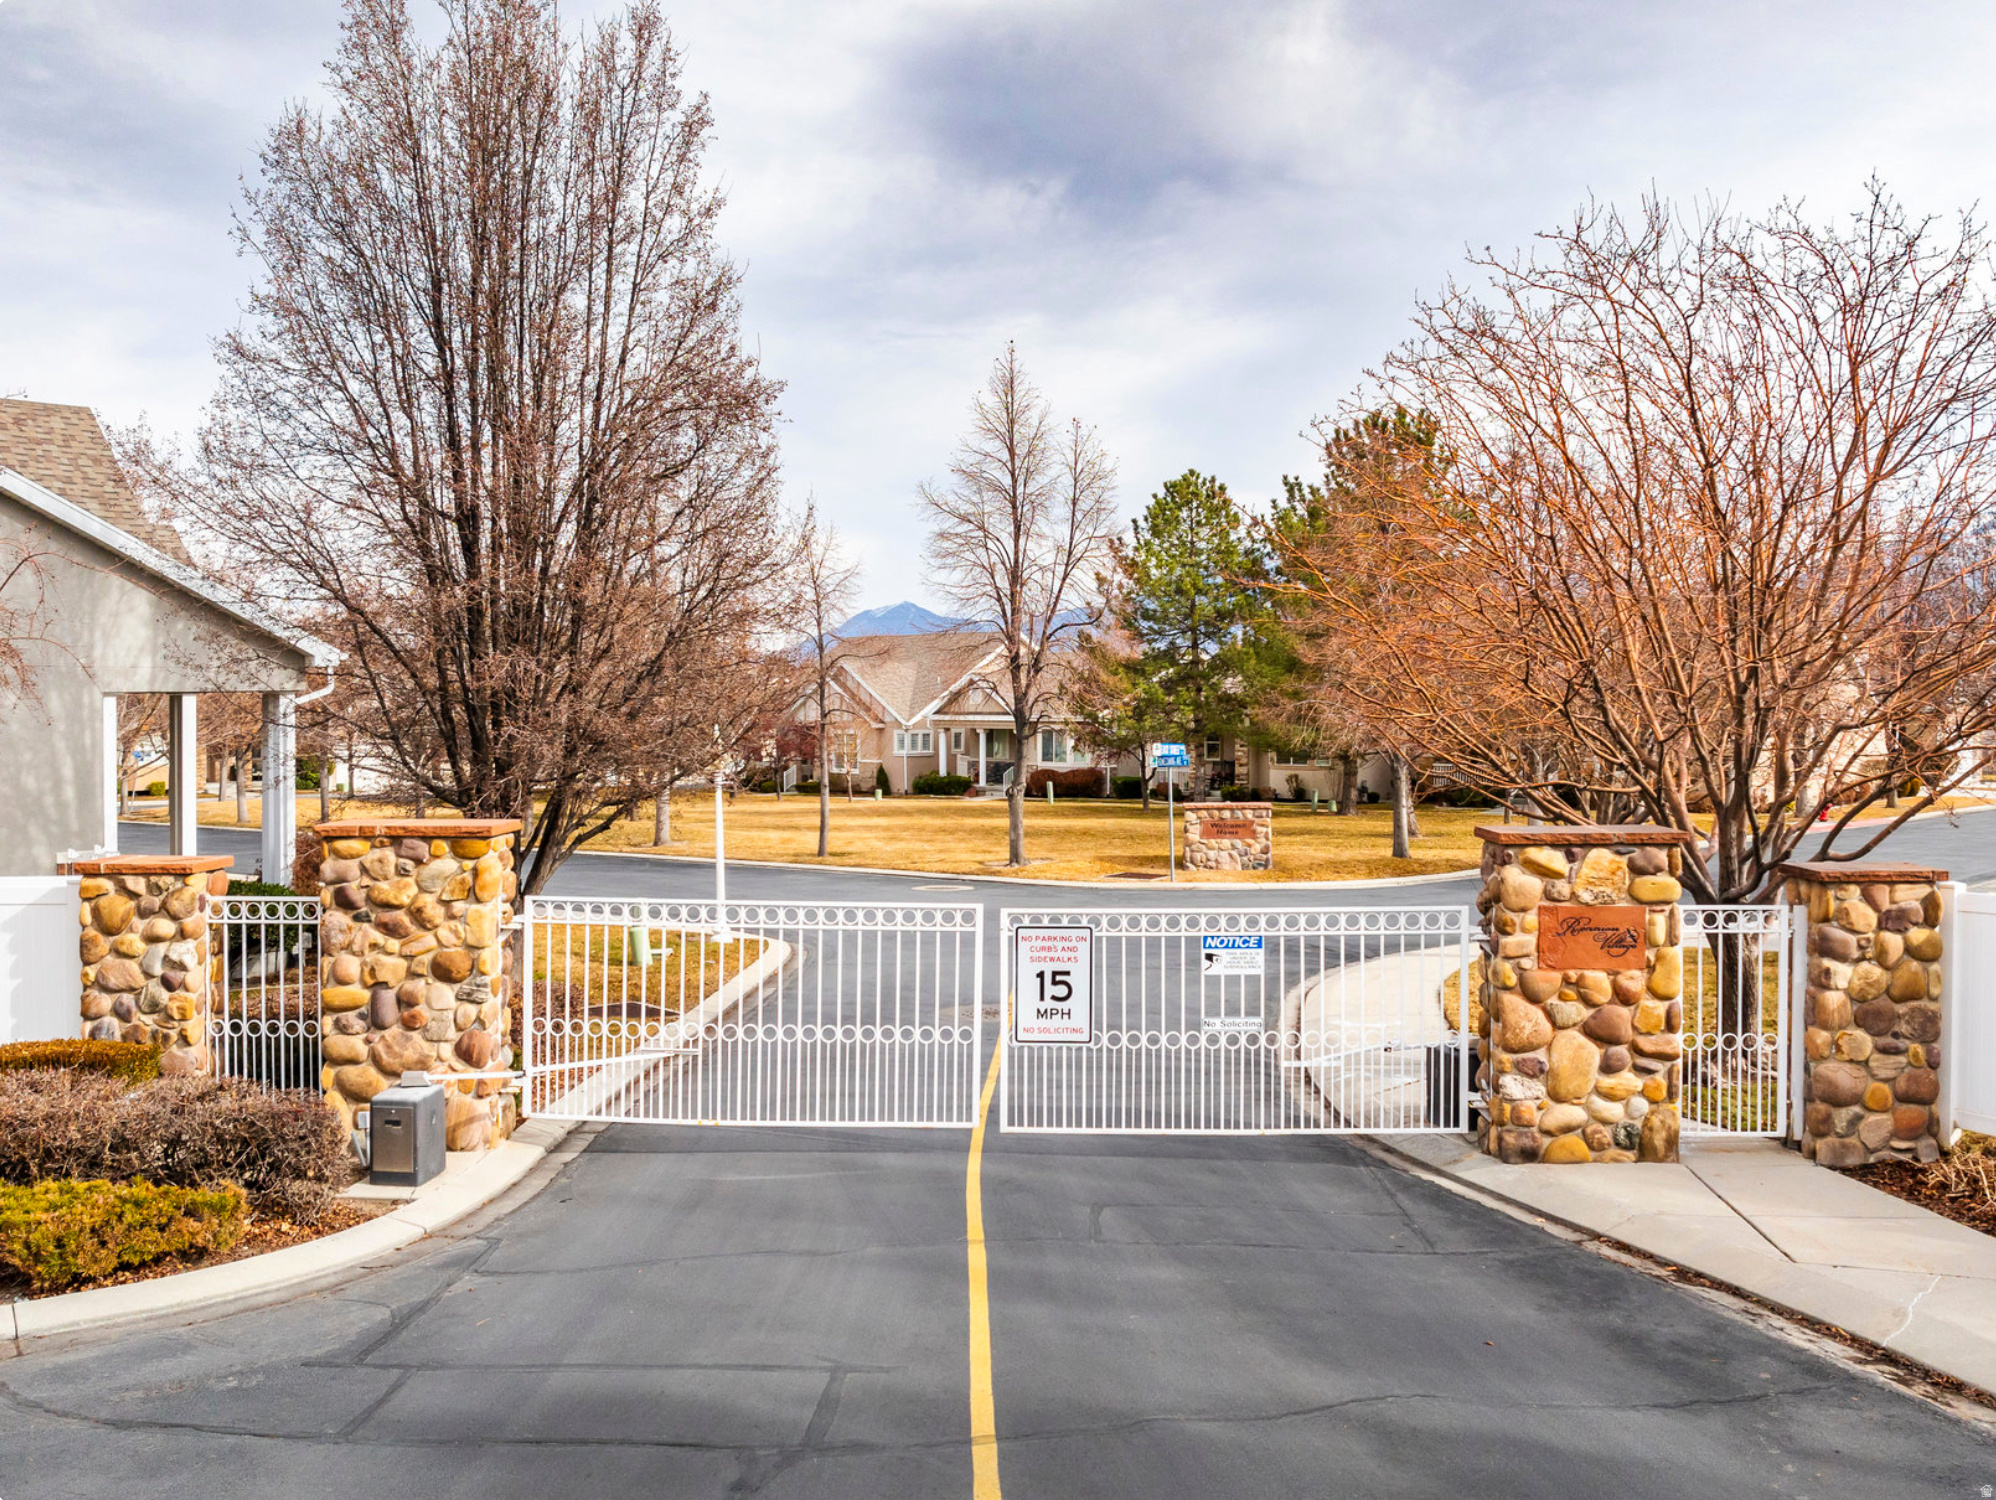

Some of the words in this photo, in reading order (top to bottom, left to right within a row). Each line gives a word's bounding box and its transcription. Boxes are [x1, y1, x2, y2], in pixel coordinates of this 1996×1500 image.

[1021, 935, 1033, 943] NO
[1035, 935, 1073, 943] PARKING
[1075, 935, 1087, 943] ON
[1205, 936, 1260, 948] NOTICE
[1593, 930, 1637, 957] Village
[1029, 945, 1058, 953] CURBS
[1060, 945, 1079, 953] AND
[1035, 970, 1073, 1002] 15
[1036, 1008, 1071, 1020] MPH
[1220, 1020, 1262, 1029] Soliciting
